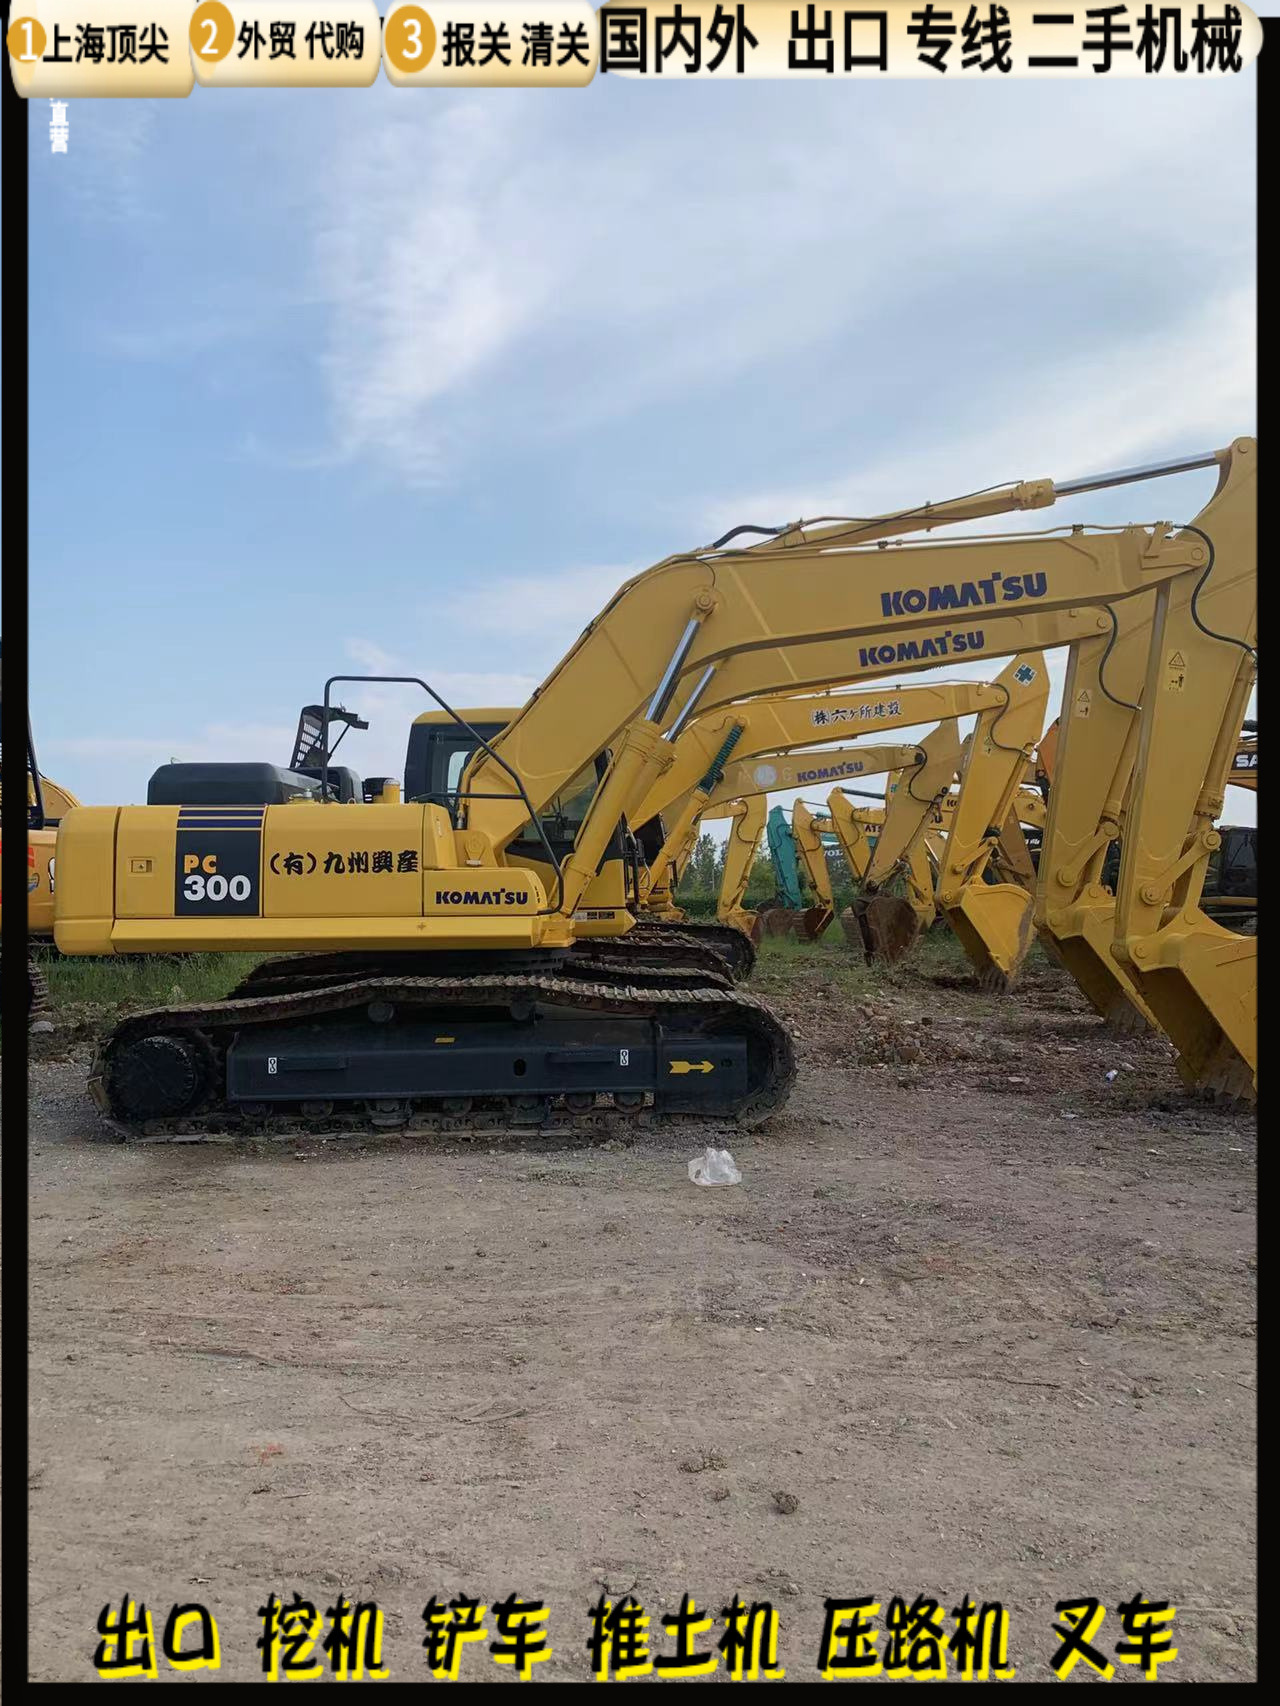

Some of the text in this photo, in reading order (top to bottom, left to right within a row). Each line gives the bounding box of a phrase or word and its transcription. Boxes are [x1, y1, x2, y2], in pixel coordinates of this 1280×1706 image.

[881, 572, 1047, 616] KOMATSU
[859, 630, 985, 667] KOMATSU
[797, 761, 864, 783] KOMATSU
[184, 854, 217, 874] PC
[183, 874, 252, 902] 300
[435, 887, 528, 905] KOMATSU
